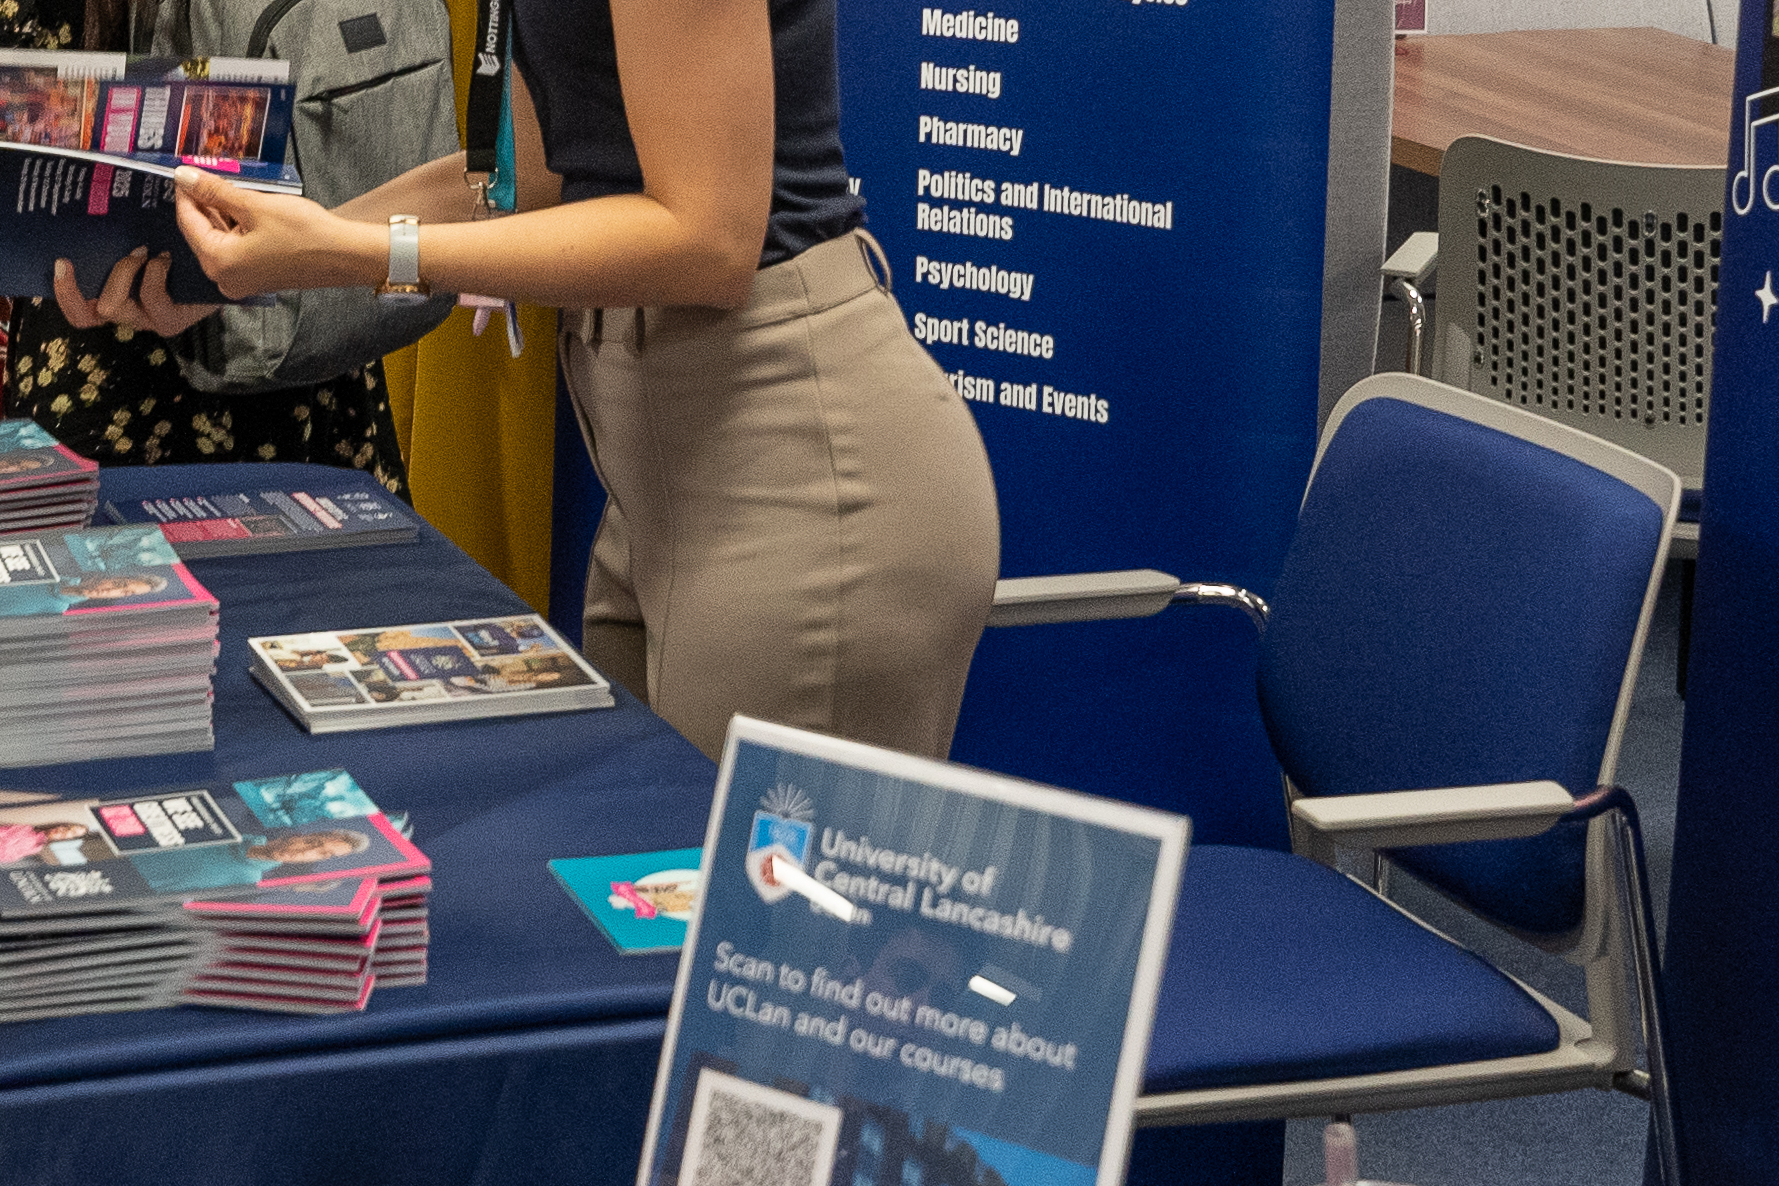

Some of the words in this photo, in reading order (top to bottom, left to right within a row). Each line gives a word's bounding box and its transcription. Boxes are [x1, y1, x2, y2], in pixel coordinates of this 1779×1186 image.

[921, 7, 1019, 44] Medicine
[920, 61, 1002, 99] Nursing
[918, 115, 1024, 157] Pharmacy
[916, 202, 1014, 241] Relations
[917, 168, 996, 204] Politics
[1000, 181, 1039, 210] and
[1043, 183, 1173, 230] International
[915, 255, 1035, 302] Psychology
[913, 312, 970, 347] Sport
[973, 320, 1054, 360] Science
[943, 368, 995, 404] rism
[999, 381, 1038, 411] and
[1042, 385, 1109, 424] Events
[822, 827, 960, 893] University
[961, 865, 997, 897] of
[814, 860, 917, 911] Central
[920, 887, 1071, 954] Lancashire
[715, 940, 774, 982] Scan
[779, 962, 807, 993] to
[810, 966, 865, 1010] find
[865, 988, 913, 1023] out
[915, 1003, 989, 1045] more
[990, 1020, 1078, 1071] about
[707, 981, 792, 1029] UCLan
[794, 1014, 849, 1046] and
[849, 1027, 898, 1061] our
[899, 1042, 1006, 1093] courses
